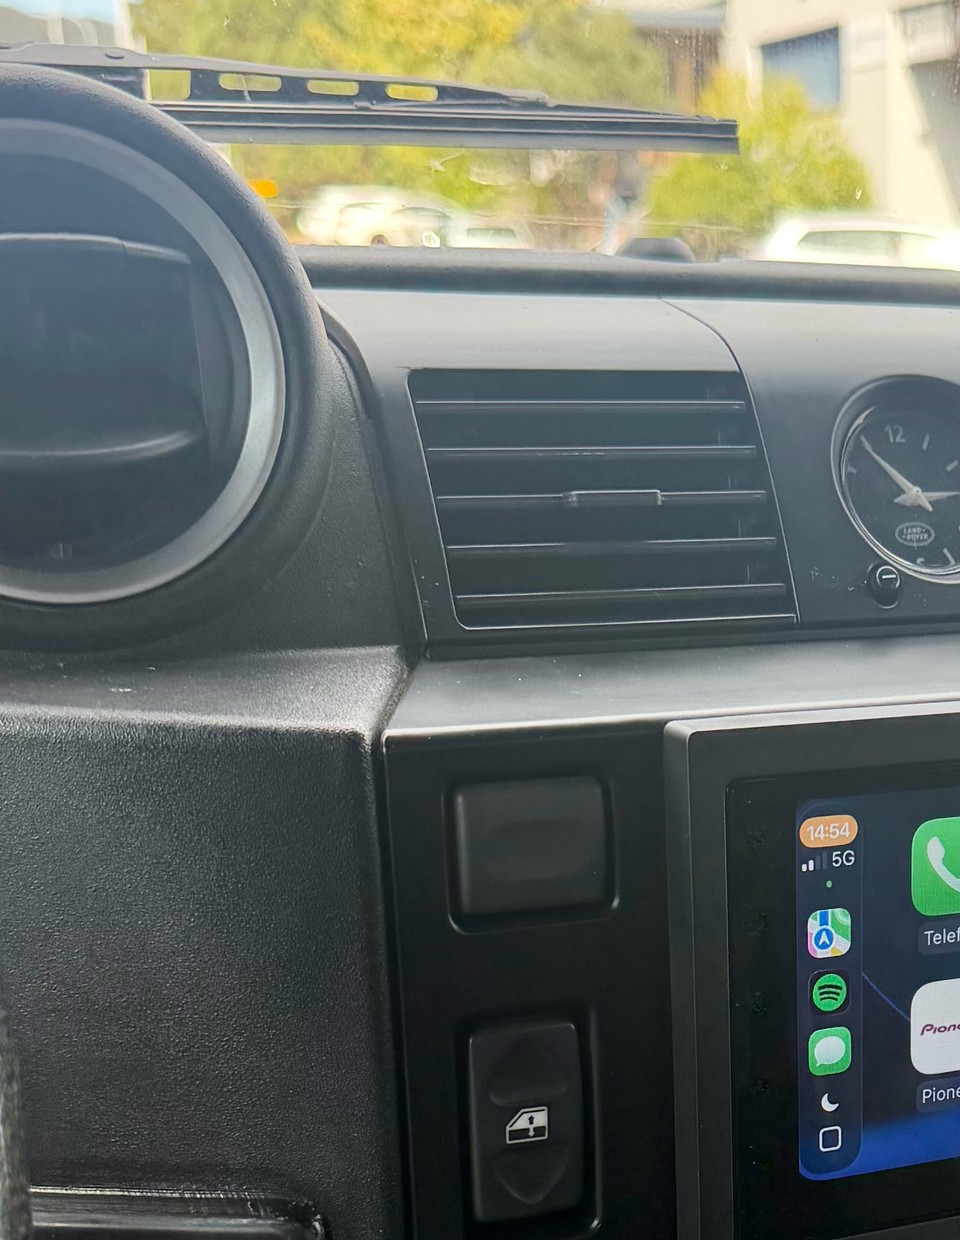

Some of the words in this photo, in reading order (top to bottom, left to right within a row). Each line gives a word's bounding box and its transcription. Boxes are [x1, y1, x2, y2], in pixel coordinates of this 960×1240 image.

[884, 424, 906, 443] 12
[806, 821, 851, 841] 14:54
[831, 849, 856, 868] 5G
